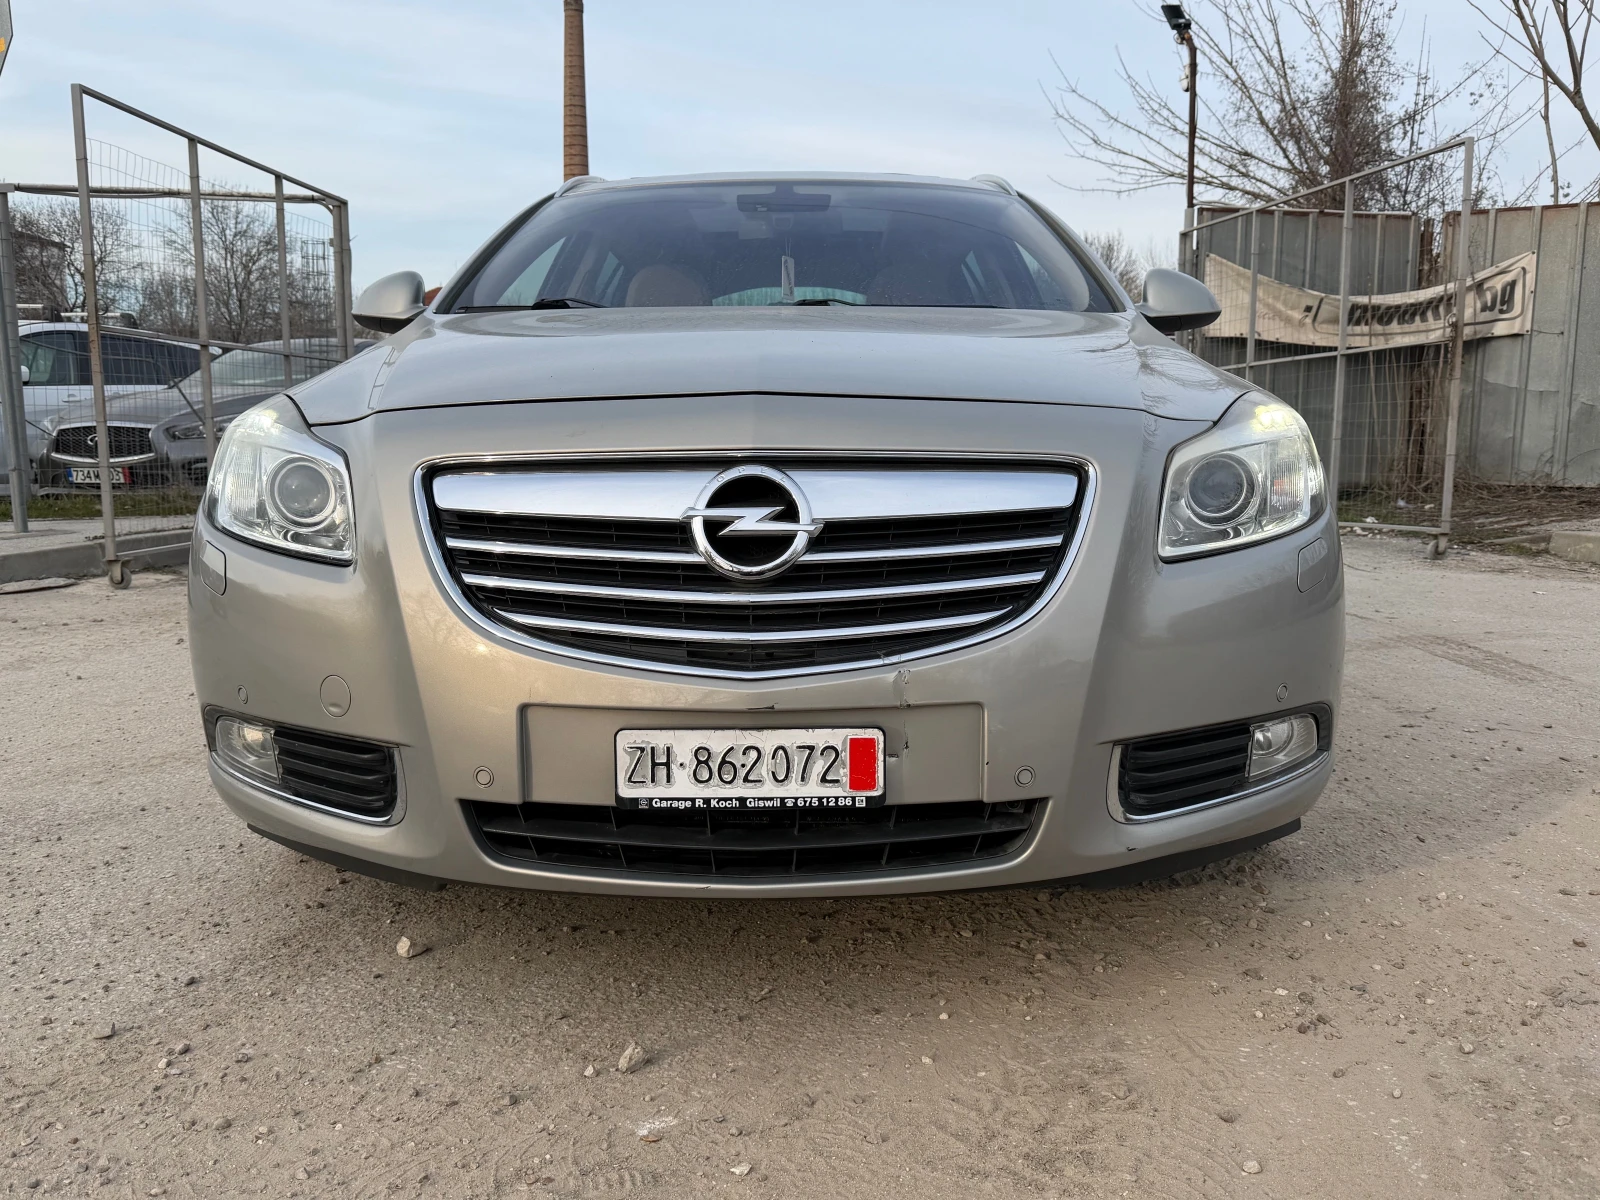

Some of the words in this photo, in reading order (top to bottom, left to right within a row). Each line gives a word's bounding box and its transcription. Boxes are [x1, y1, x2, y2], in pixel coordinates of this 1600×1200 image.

[715, 465, 787, 484] OPEL
[651, 798, 692, 809] Garage
[695, 798, 707, 808] R.
[710, 798, 740, 808] Koch
[746, 797, 781, 807] Giswil
[797, 796, 819, 807] 675
[821, 796, 836, 807] 12
[838, 796, 853, 806] 86
